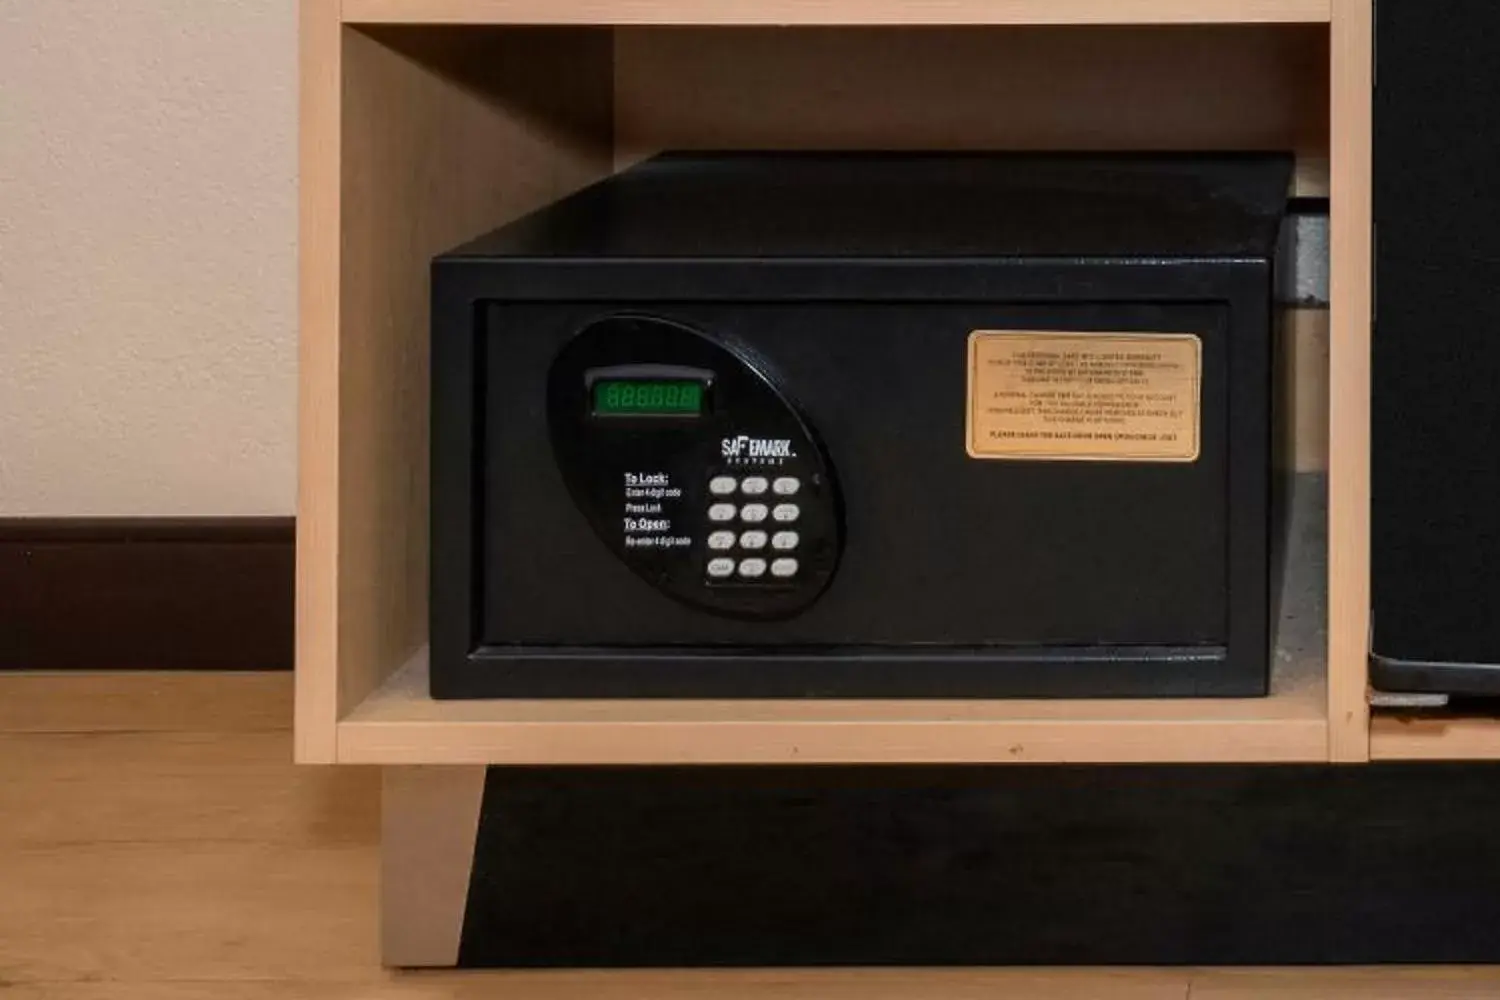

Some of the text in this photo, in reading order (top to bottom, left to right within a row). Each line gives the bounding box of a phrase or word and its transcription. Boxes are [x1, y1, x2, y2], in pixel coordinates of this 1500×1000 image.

[721, 435, 793, 457] SAFEMARK
[624, 472, 669, 486] To Lock:
[624, 518, 671, 531] To Open:
